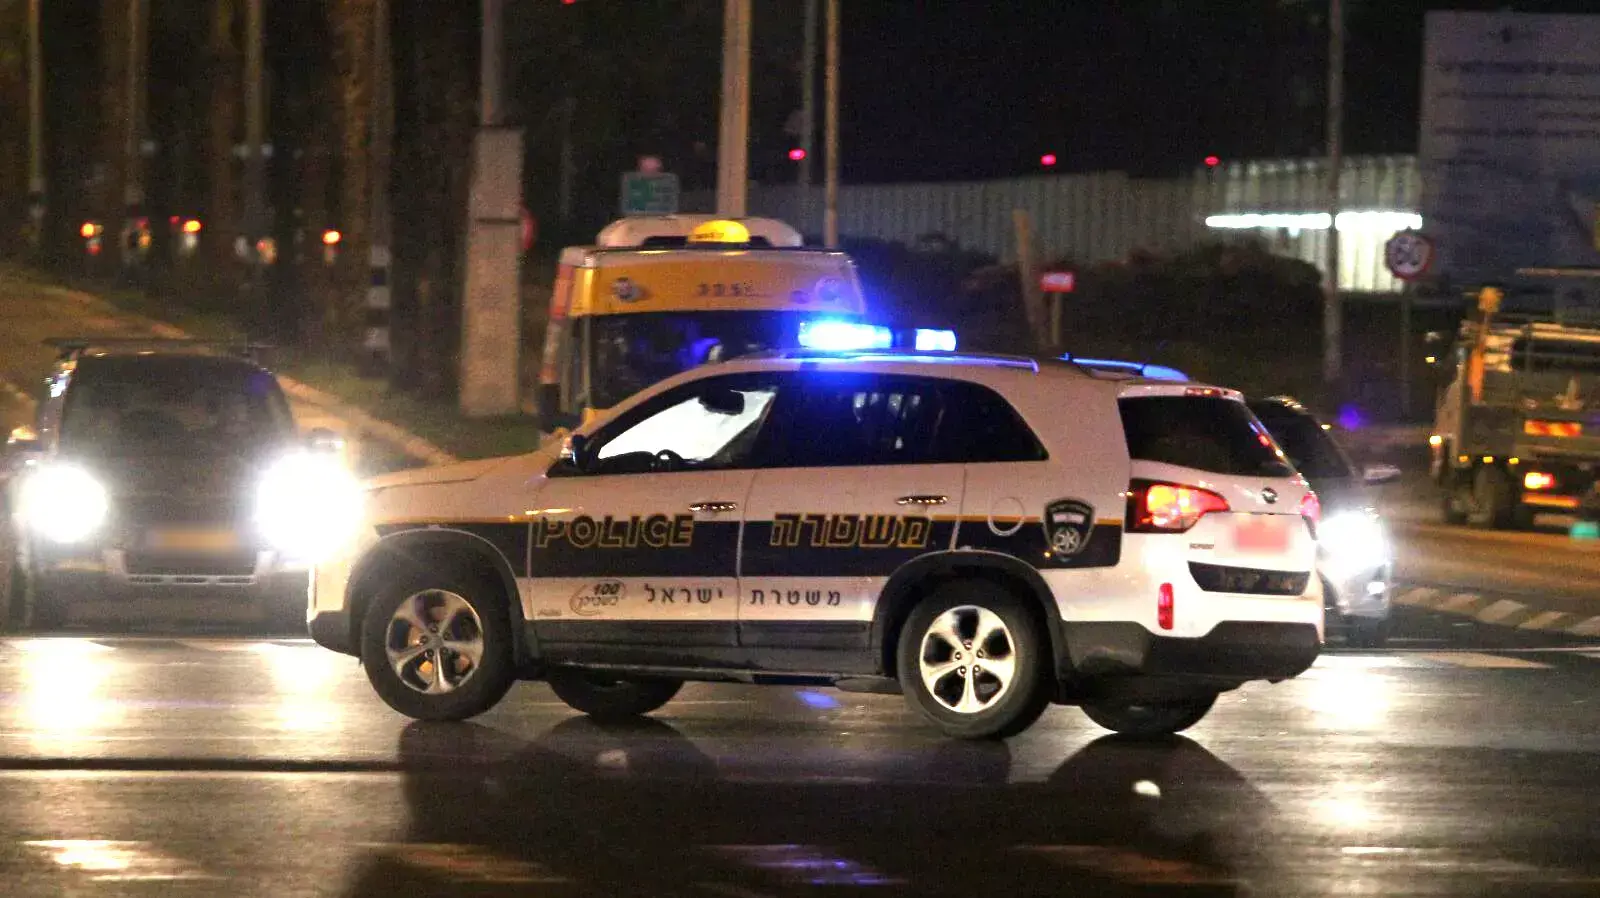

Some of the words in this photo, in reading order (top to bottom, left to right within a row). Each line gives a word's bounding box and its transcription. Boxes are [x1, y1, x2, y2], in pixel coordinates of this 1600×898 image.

[536, 514, 694, 548] POLICE
[770, 512, 931, 547] משטרה
[594, 583, 620, 595] 100
[643, 582, 724, 604] ישראל
[750, 588, 841, 606] משטרת
